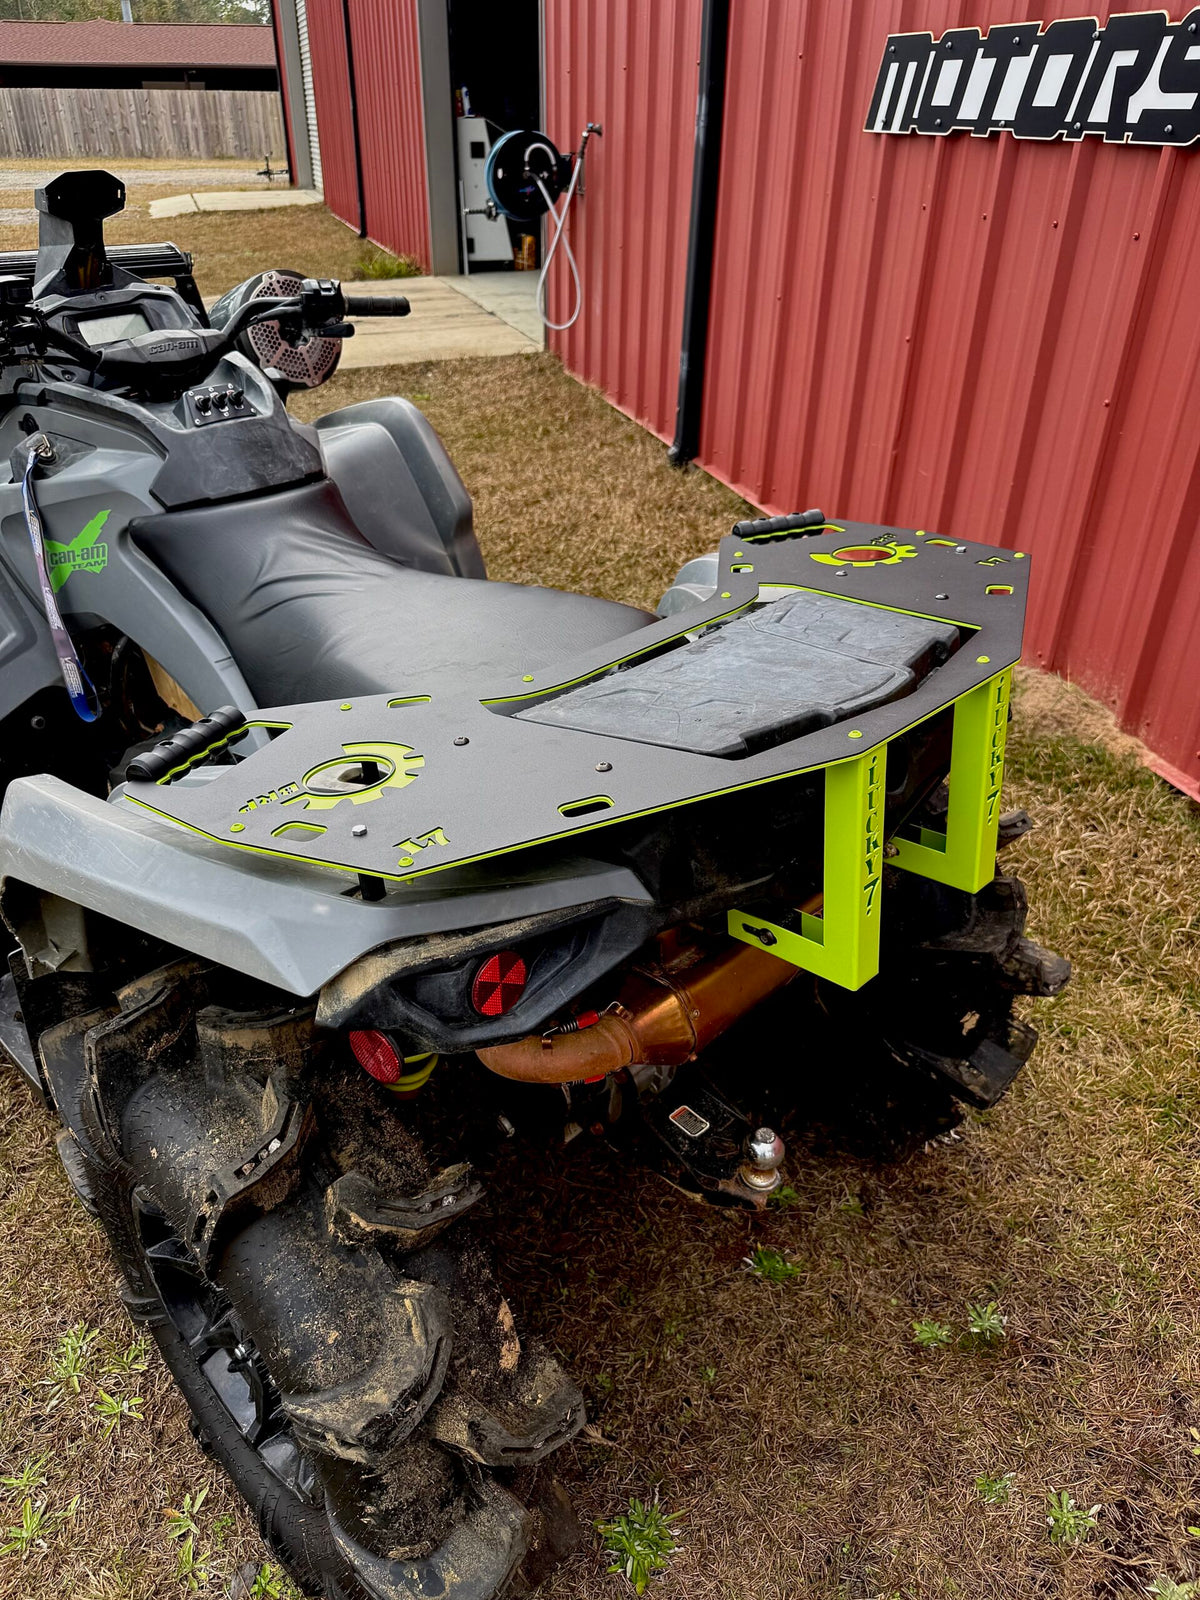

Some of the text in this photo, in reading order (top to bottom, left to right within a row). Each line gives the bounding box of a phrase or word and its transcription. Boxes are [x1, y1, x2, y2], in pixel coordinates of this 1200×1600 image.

[148, 338, 200, 355] can-am
[49, 543, 106, 566] can-am
[71, 559, 107, 570] TEAM
